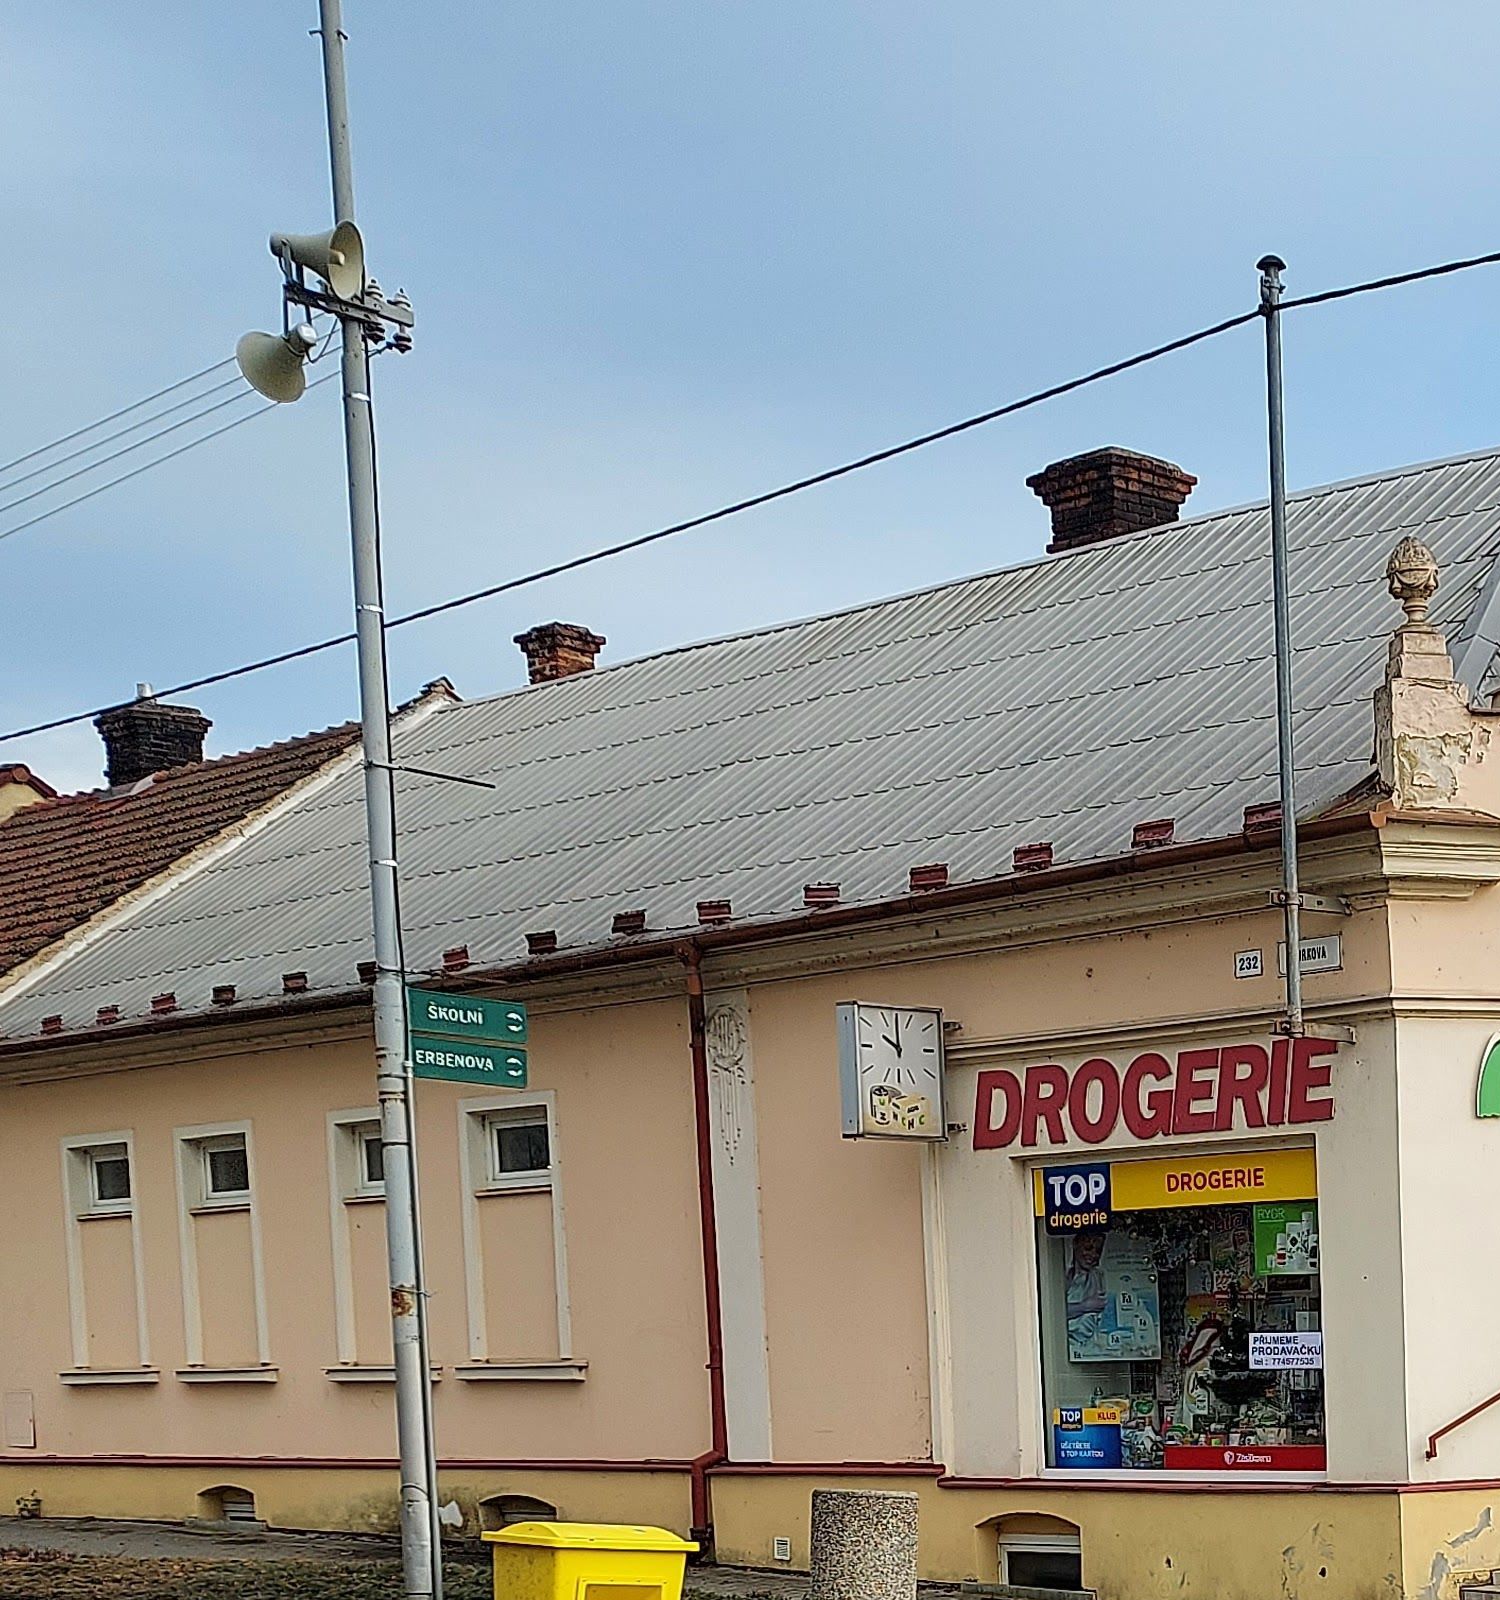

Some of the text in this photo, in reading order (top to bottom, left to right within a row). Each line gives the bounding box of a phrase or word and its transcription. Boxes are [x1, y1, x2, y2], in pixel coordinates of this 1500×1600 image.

[1238, 955, 1259, 971] 232
[427, 1001, 484, 1025] ŠKOLNÍ
[415, 1049, 494, 1072] ERBENOVA
[973, 1036, 1339, 1150] DROGERIE
[1048, 1172, 1107, 1207] TOP
[1165, 1166, 1265, 1193] DROGERIE
[1049, 1208, 1108, 1229] drogerie
[1121, 1292, 1132, 1304] Fa
[1251, 1344, 1321, 1356] PRODAVAČKU
[1253, 1334, 1299, 1345] PŘIJMEME
[1061, 1410, 1081, 1422] TOP
